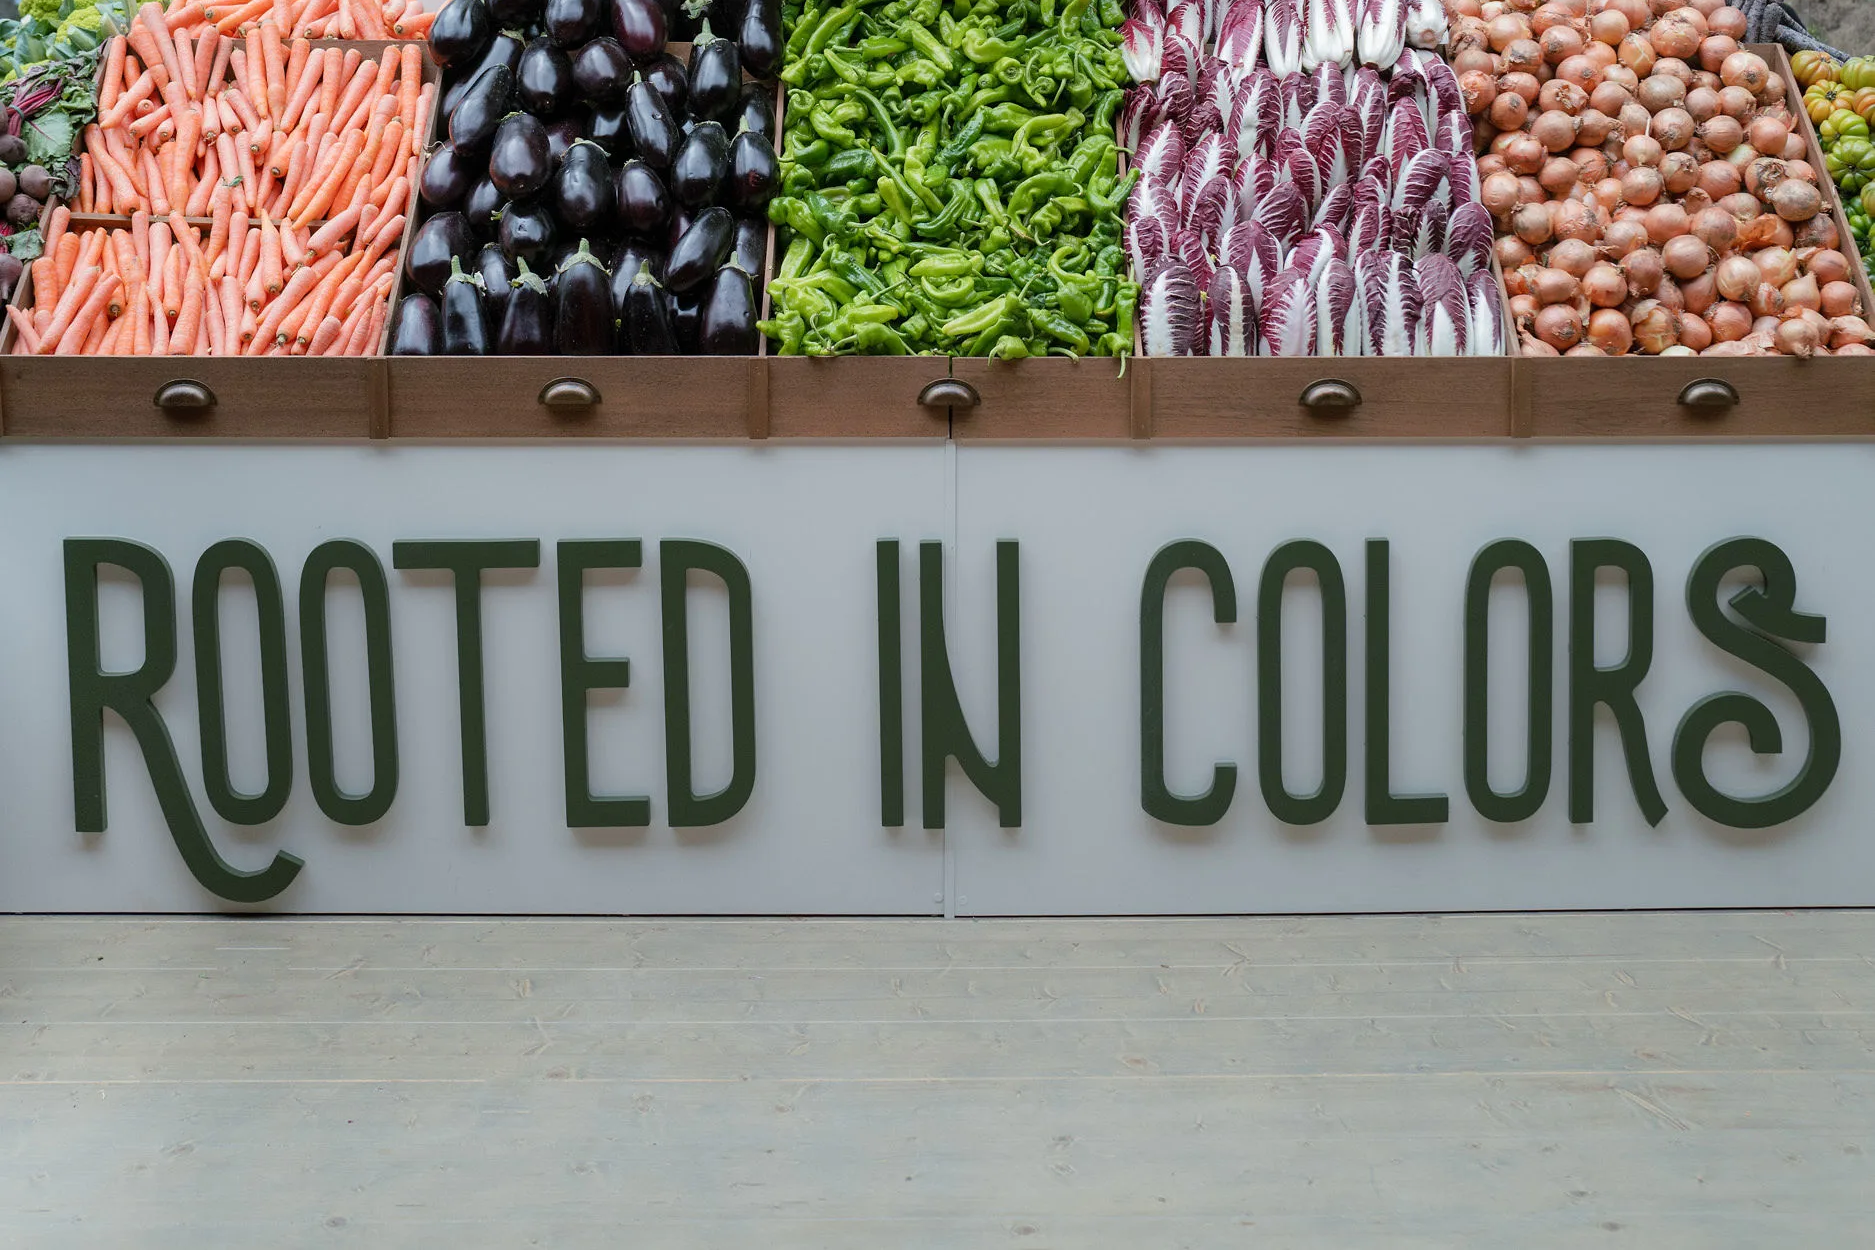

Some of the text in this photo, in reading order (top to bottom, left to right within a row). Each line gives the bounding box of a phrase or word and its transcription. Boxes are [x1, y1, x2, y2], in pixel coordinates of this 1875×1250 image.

[62, 536, 1843, 904] ROOTED IN COLORS
